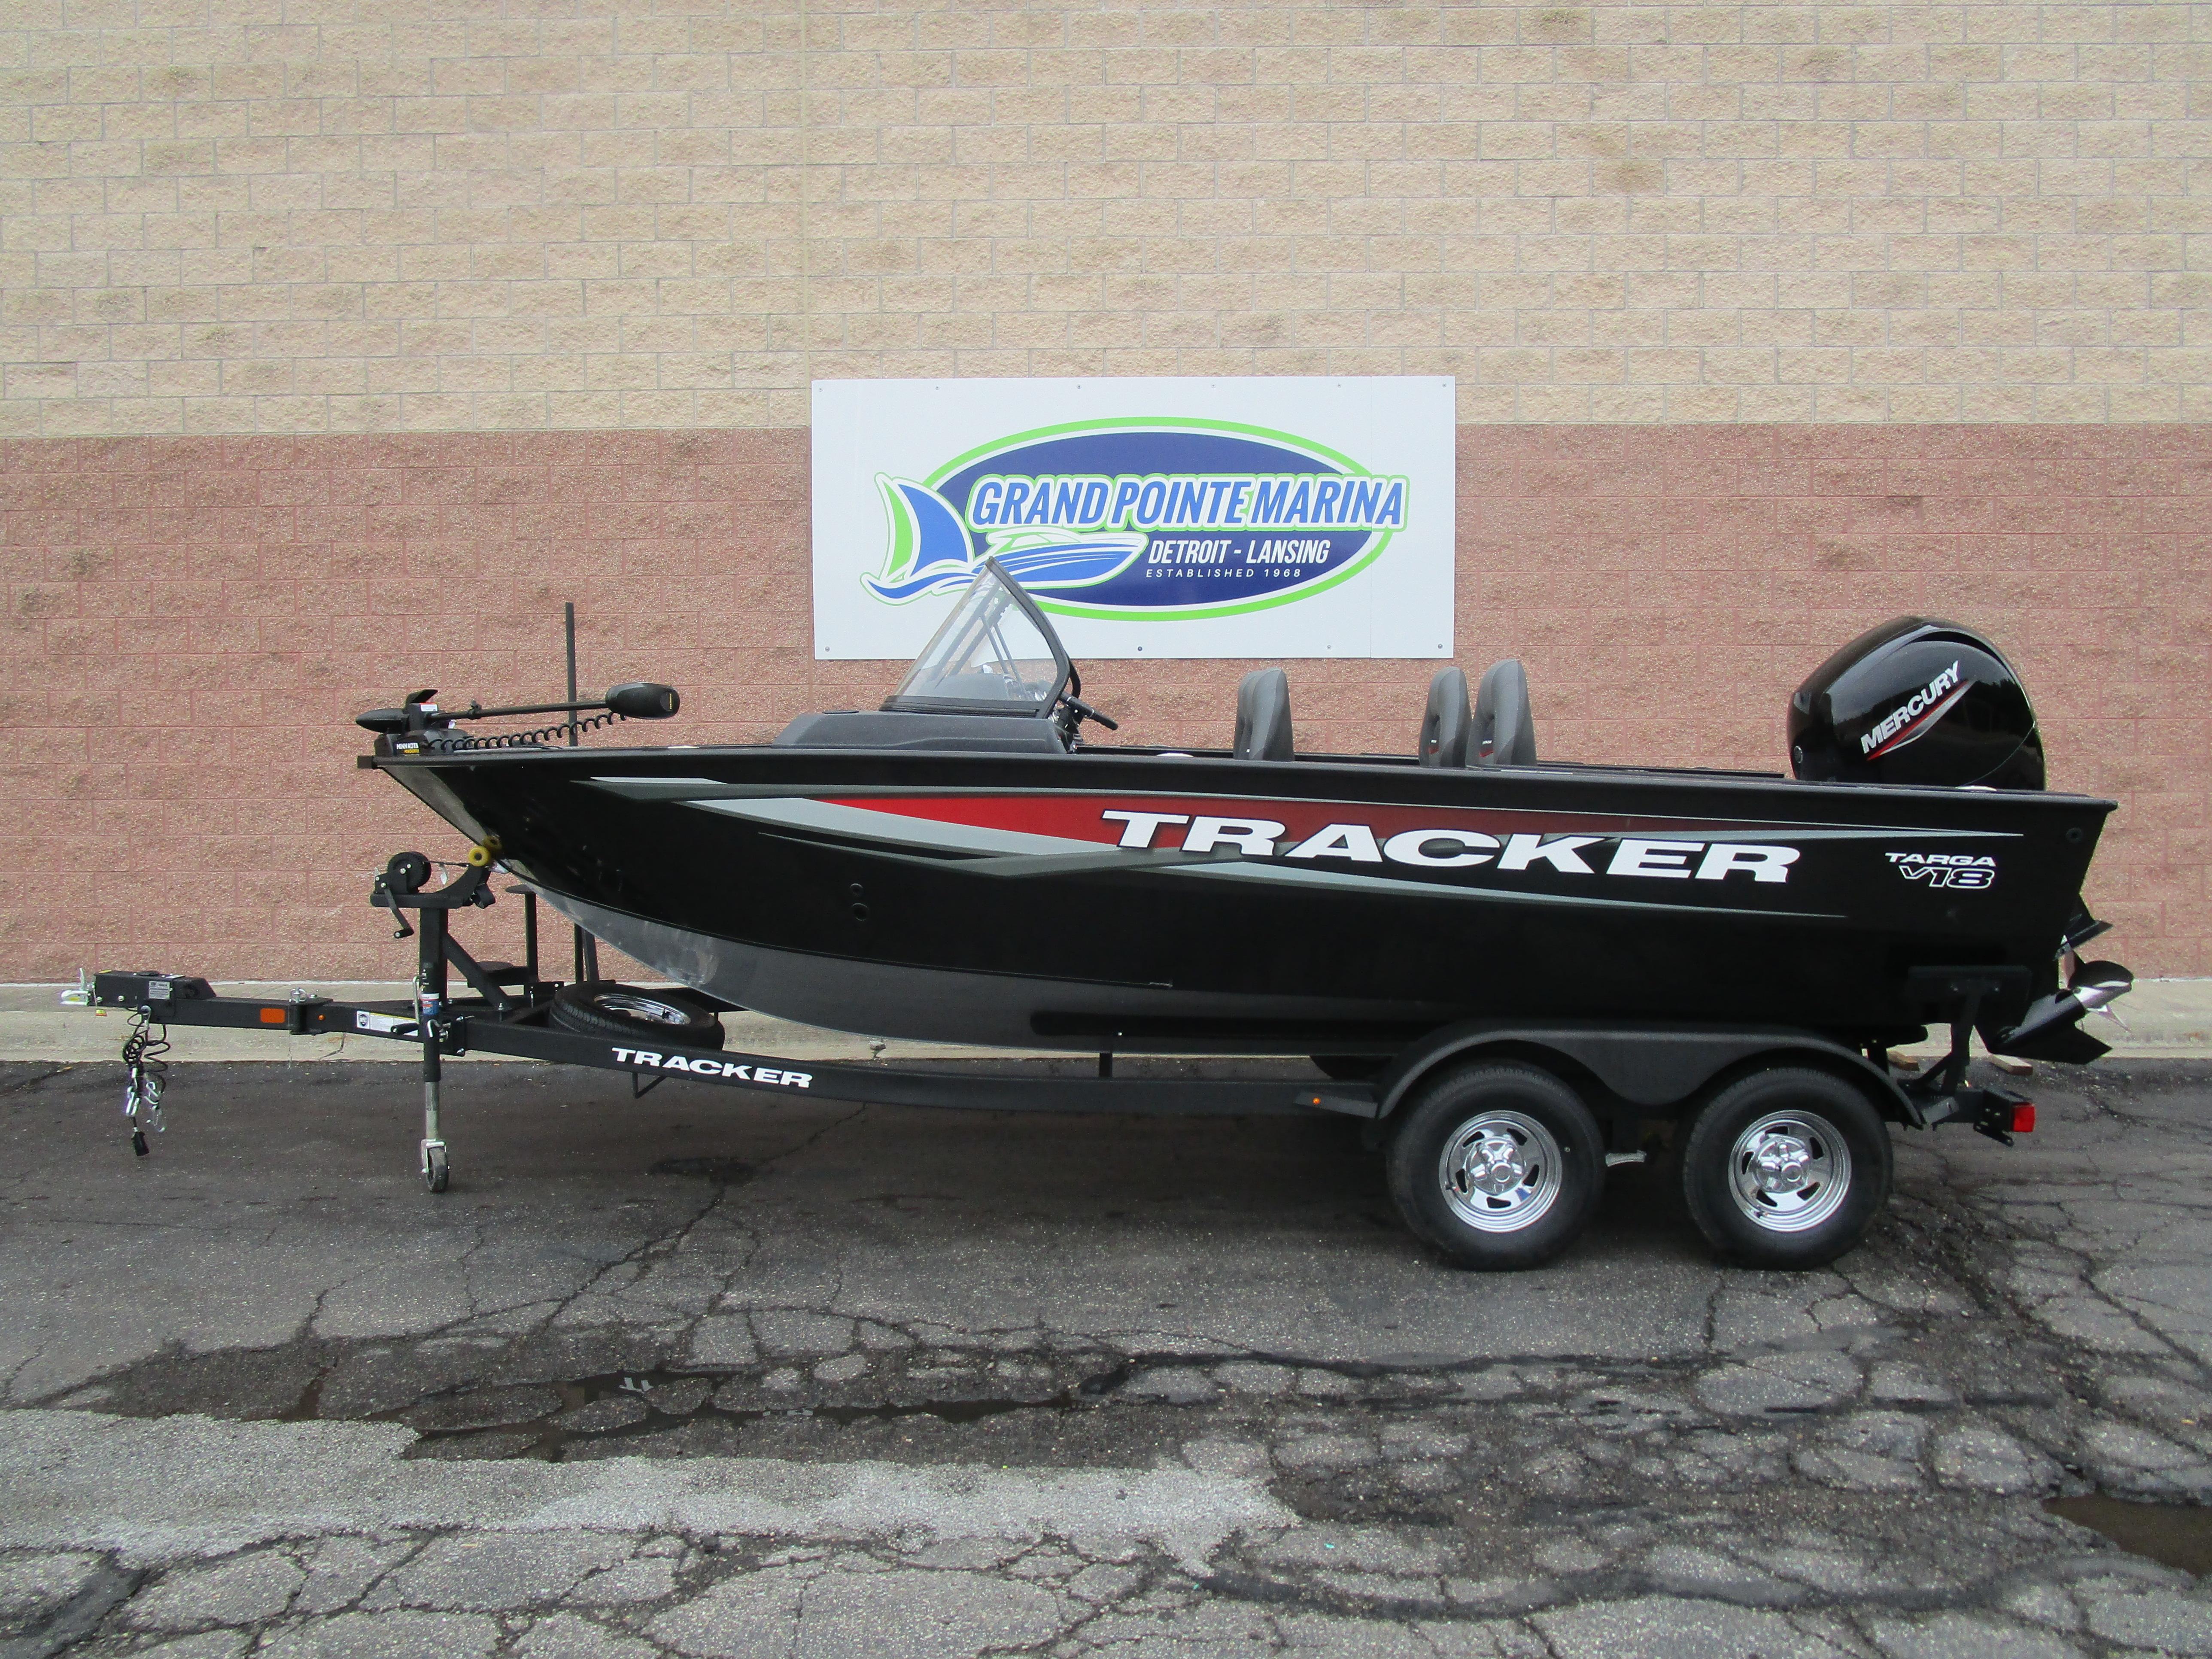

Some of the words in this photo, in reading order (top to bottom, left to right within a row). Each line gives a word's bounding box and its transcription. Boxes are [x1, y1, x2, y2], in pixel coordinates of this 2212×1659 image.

[972, 481, 1109, 526] GRAND
[1111, 480, 1252, 525] POINTE
[1252, 480, 1403, 525] MARINA
[1148, 539, 1232, 564] DETROIT
[1246, 539, 1331, 564] LANSING
[1146, 568, 1255, 578] ESTABLISHED
[1264, 568, 1301, 577] 1968
[1860, 660, 1959, 754] MERCURY
[1102, 810, 1800, 883] TRACKER
[1884, 852, 1996, 867] TARGA
[1899, 865, 1995, 890] V18
[611, 1047, 813, 1089] TRACKER
